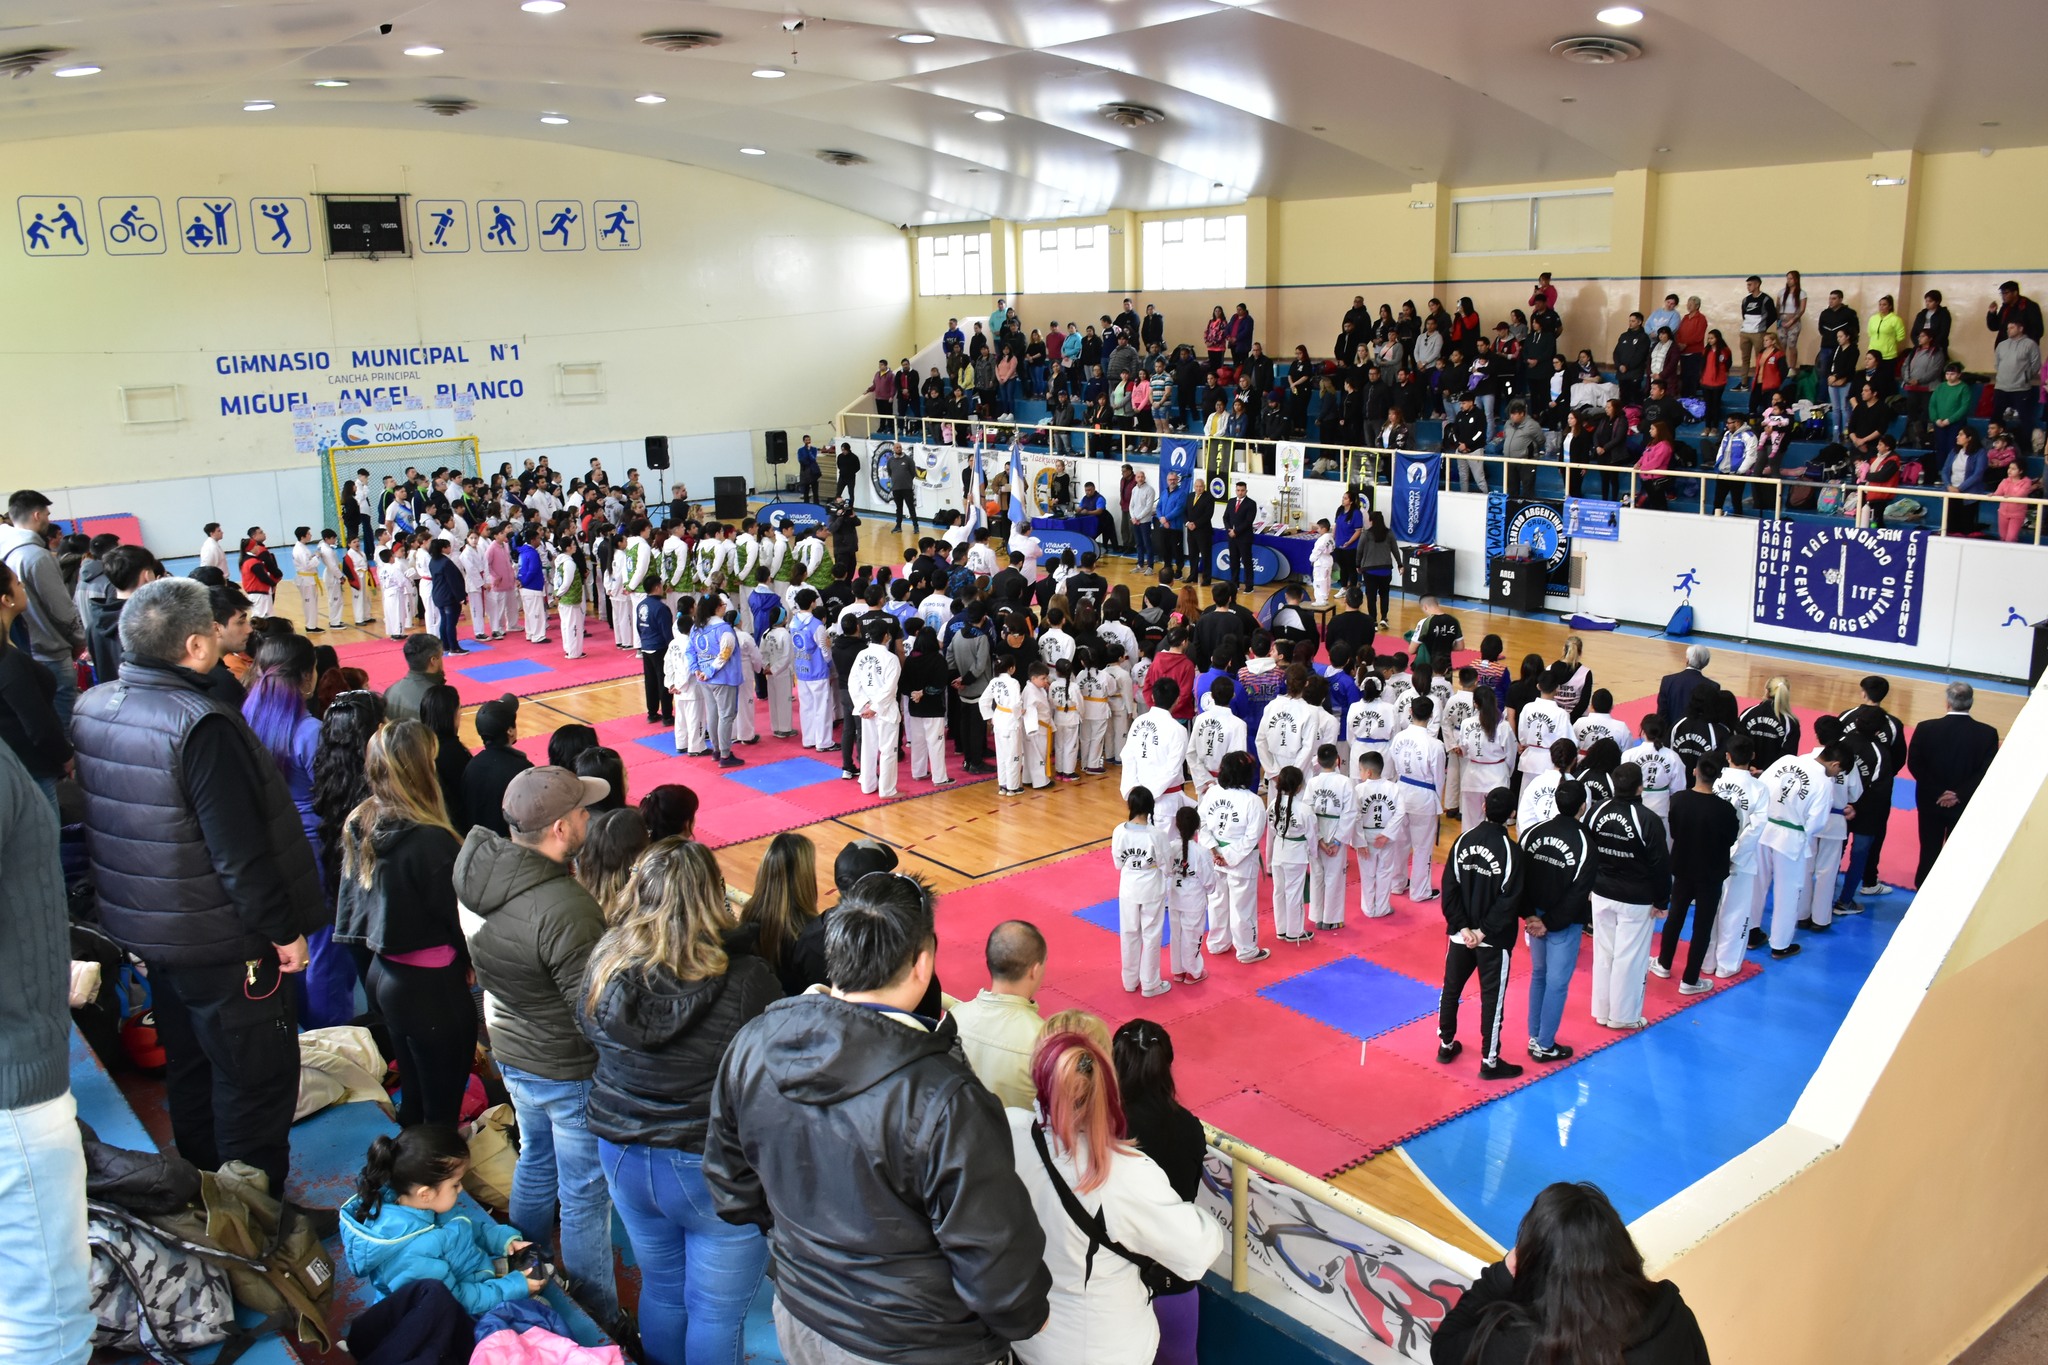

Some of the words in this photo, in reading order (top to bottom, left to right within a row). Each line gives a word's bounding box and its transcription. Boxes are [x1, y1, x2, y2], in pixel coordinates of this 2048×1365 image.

[216, 351, 331, 375] GIMNASIO
[352, 345, 470, 368] MUNICIPAL
[328, 374, 369, 385] CANCHA
[371, 371, 421, 383] PRINCIPAL
[374, 420, 418, 432] VIVAMOS
[375, 427, 444, 443] COMODORO
[1359, 456, 1368, 491] FATI
[1524, 506, 1563, 531] ARGENTINO
[1527, 519, 1552, 530] GRUPO
[1876, 527, 1903, 543] SAN
[1770, 519, 1782, 576] RAUL
[1409, 556, 1420, 567] AREA
[1411, 567, 1418, 583] 5
[1500, 569, 1515, 580] AREA
[1502, 580, 1511, 596] 3
[1851, 585, 1877, 601] ITF
[1794, 565, 1825, 623] CENTRO
[1829, 576, 1896, 632] ARGENTINO
